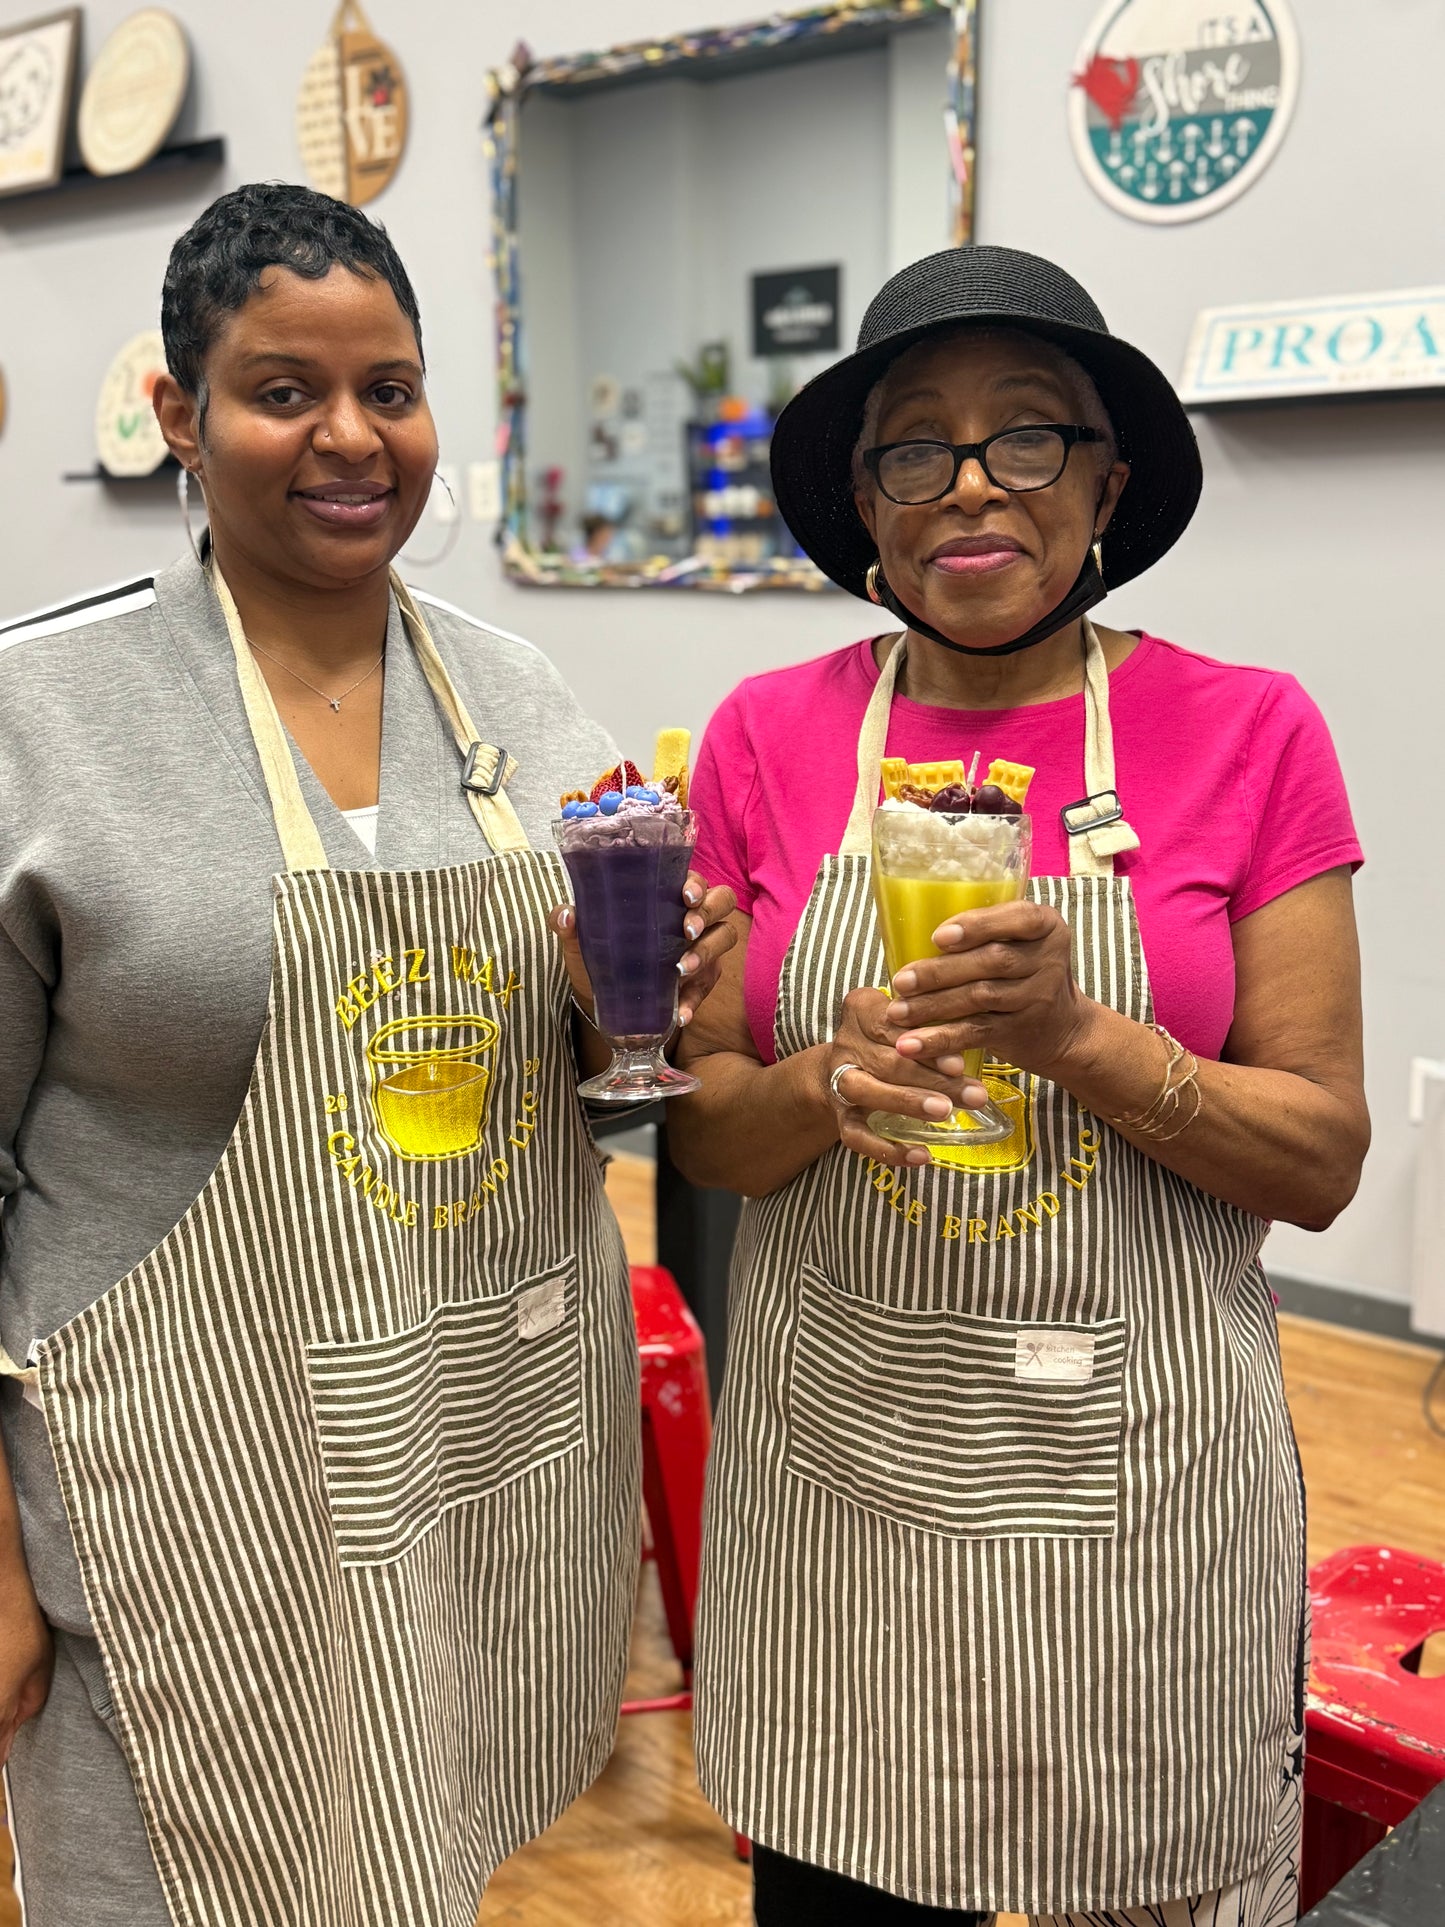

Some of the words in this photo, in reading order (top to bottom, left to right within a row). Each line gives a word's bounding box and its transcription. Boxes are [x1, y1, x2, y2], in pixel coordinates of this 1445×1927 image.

[336, 948, 431, 1030] BEEZ
[451, 945, 524, 1010] WAX
[524, 1057, 541, 1077] 20
[325, 1093, 348, 1115] 20
[327, 1130, 420, 1227] CANDLE
[433, 1158, 510, 1230] BRAND
[508, 1091, 540, 1151] LLC
[860, 1154, 927, 1226] NDLE
[941, 1191, 1061, 1244] BRAND
[1060, 1128, 1102, 1192] LLC
[1052, 1356, 1083, 1368] cooking
